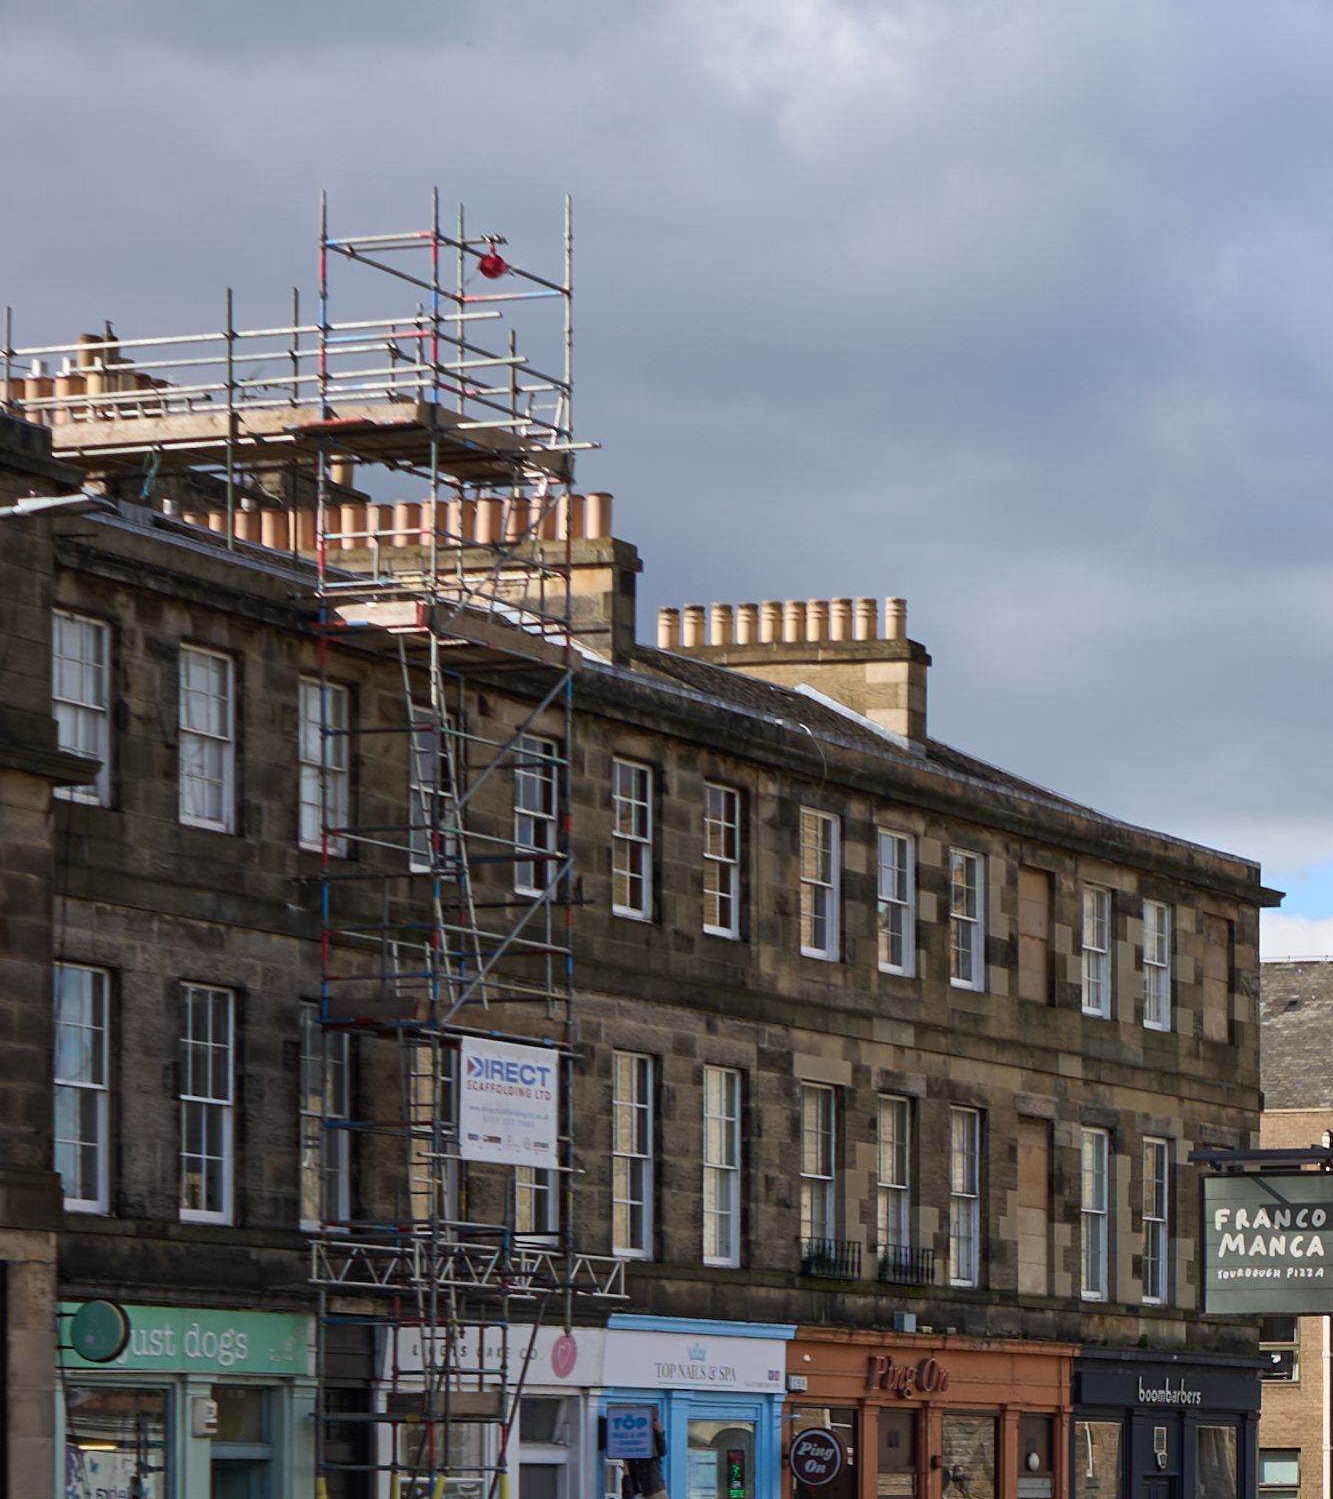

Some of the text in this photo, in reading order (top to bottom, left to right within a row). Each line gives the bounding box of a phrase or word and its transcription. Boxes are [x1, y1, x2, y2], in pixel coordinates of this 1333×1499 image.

[467, 1056, 551, 1088] DIRECT
[466, 1080, 551, 1101] SCAFFOLDING LTD
[1214, 1208, 1327, 1231] FRANCO
[1218, 1233, 1325, 1258] MANCA
[1286, 1267, 1324, 1279] PIZZA
[116, 1322, 249, 1367] ust dogs
[655, 1362, 677, 1379] TOP
[677, 1363, 706, 1380] NAILS
[719, 1366, 737, 1381] SPA
[867, 1355, 950, 1399] Ping On
[1139, 1376, 1201, 1404] boombarbers
[613, 1414, 647, 1430] TOP
[797, 1441, 835, 1461] Ping
[804, 1460, 826, 1474] On
